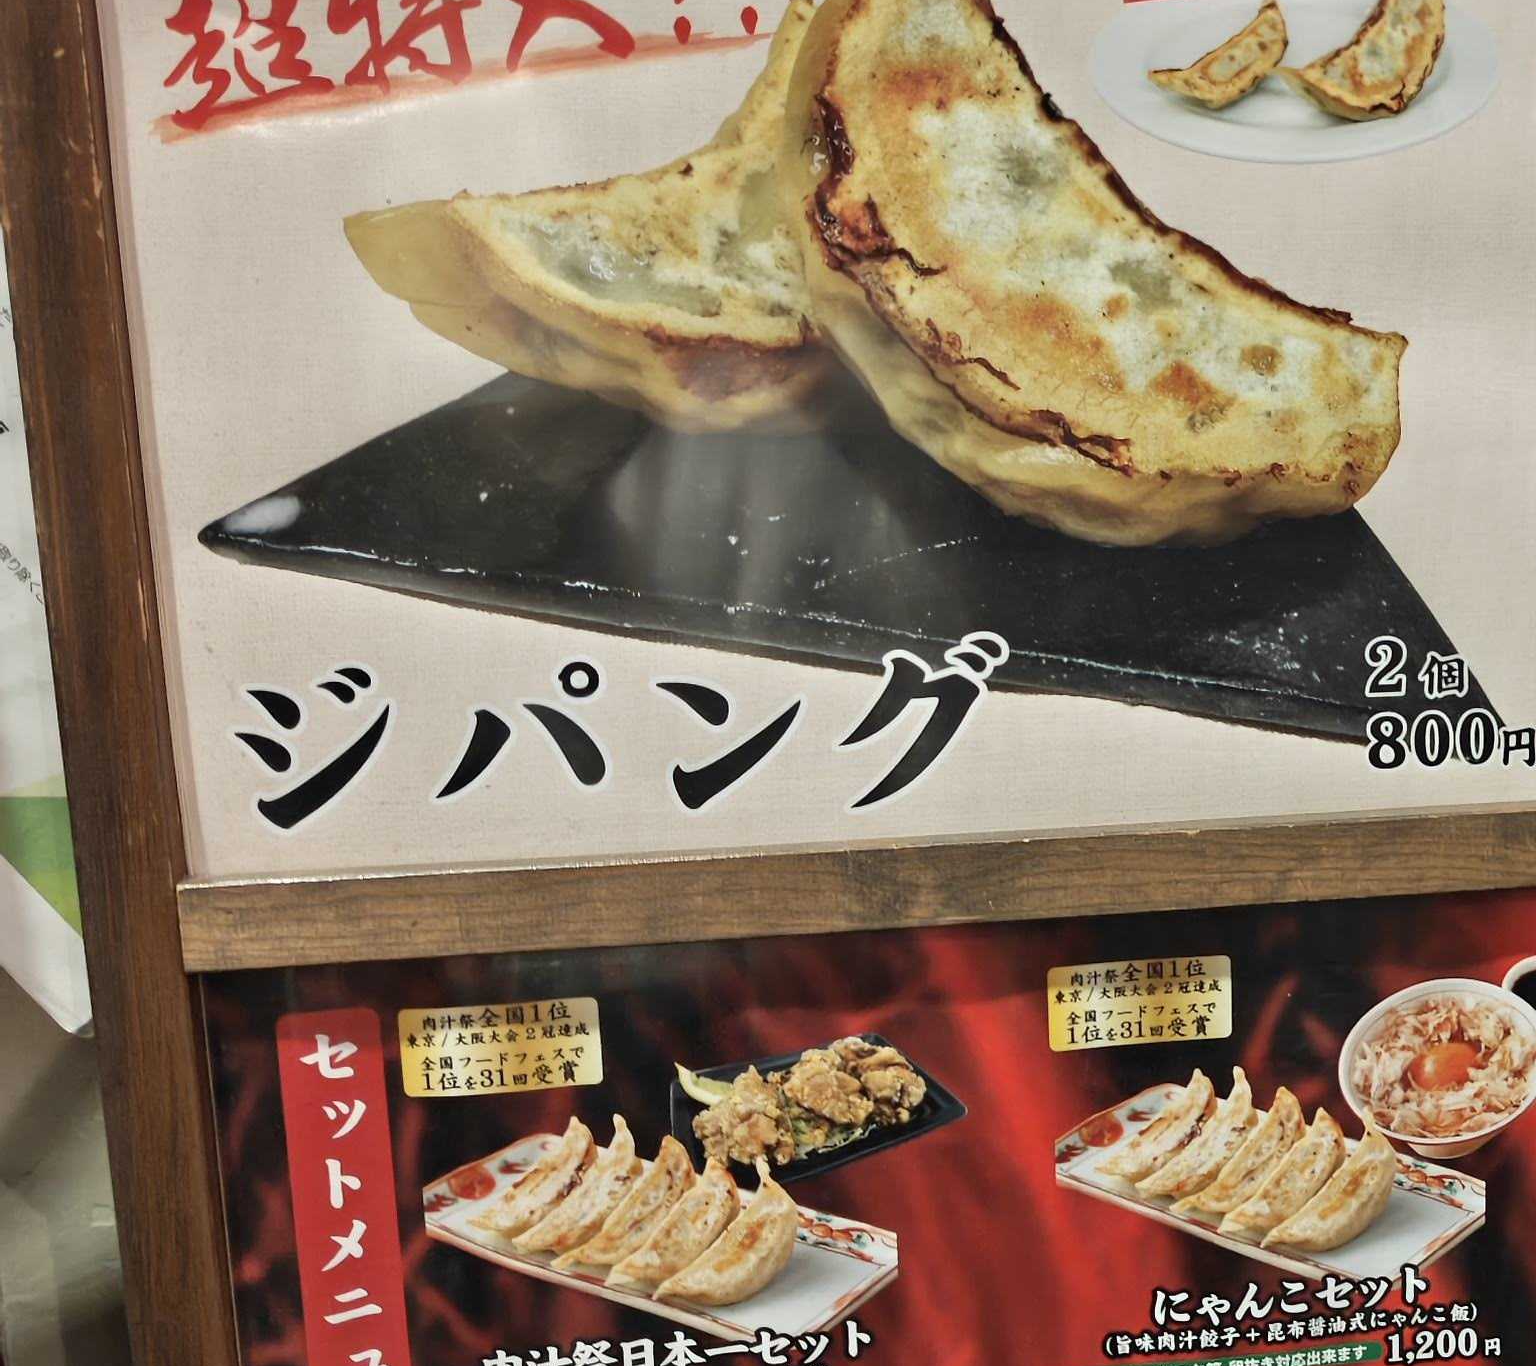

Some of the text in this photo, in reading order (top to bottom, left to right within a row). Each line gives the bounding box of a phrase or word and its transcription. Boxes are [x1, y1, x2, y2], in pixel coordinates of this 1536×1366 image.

[1366, 639, 1469, 699] 2個
[231, 631, 1010, 830] ジパング
[1070, 960, 1206, 985] 肉汁祭全国1位
[422, 1002, 571, 1030] 肉汁祭全国1位
[1067, 1003, 1216, 1026] 全国フードフェスで
[1067, 1016, 1211, 1044] 1位を31回受賞
[420, 1047, 585, 1071] 全国フードフェスで
[423, 1061, 580, 1090] 1位を31回受賞
[1154, 1267, 1428, 1326] にゃんこセット
[1387, 1328, 1502, 1364] 1,200円
